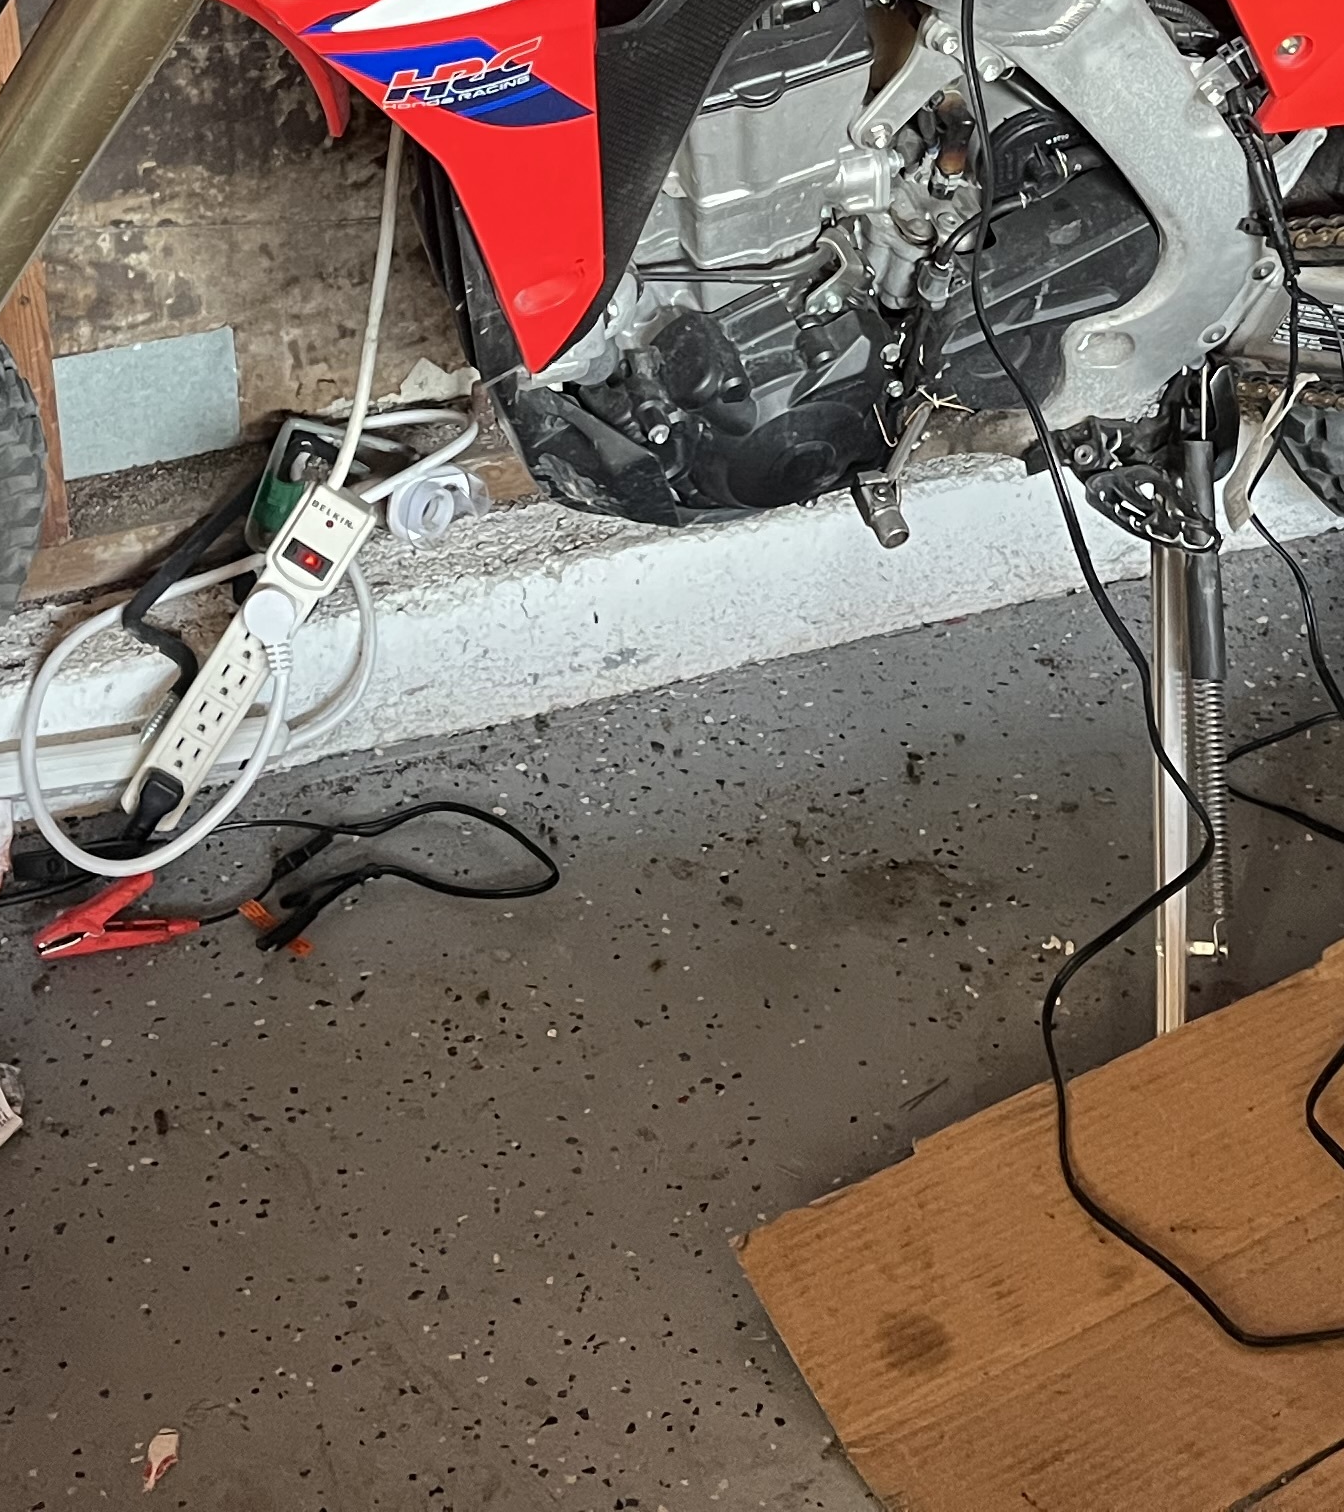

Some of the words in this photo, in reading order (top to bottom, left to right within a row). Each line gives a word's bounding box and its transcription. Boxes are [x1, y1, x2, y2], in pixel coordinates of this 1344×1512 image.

[382, 36, 542, 104] HRC
[458, 75, 531, 101] RACING
[311, 499, 354, 529] BELKIN
